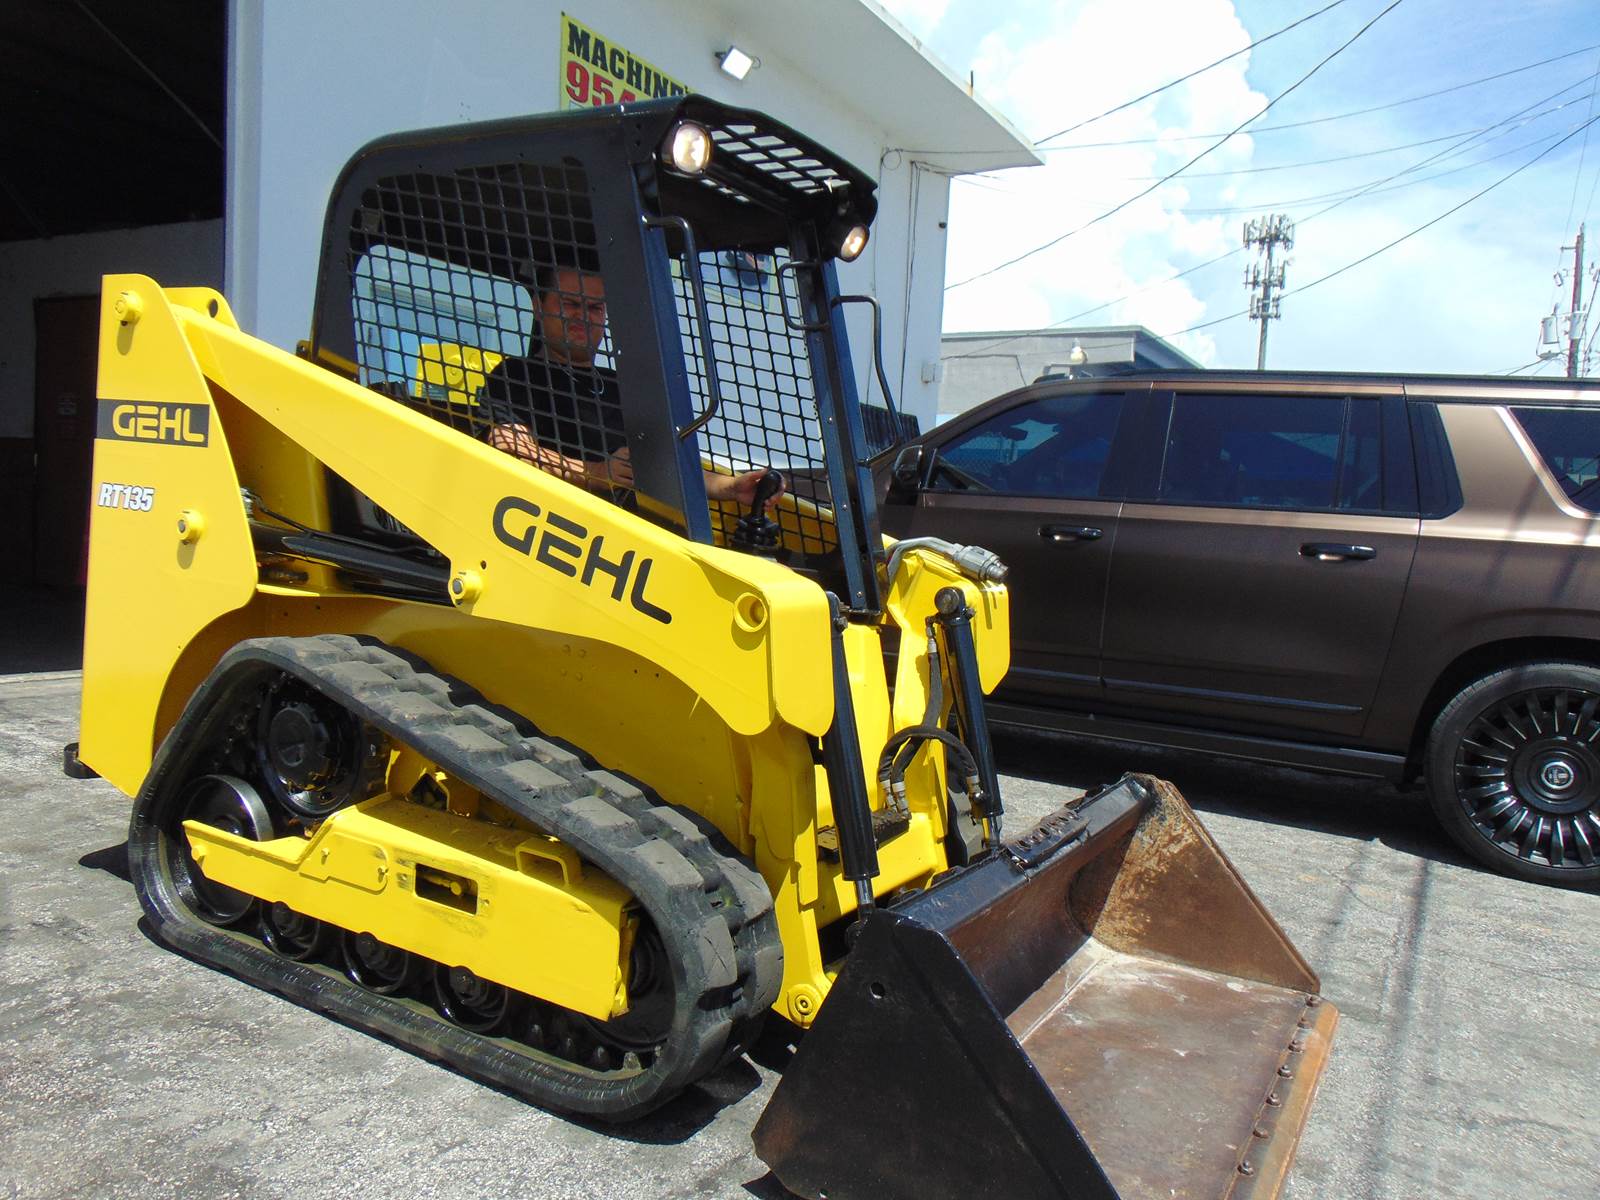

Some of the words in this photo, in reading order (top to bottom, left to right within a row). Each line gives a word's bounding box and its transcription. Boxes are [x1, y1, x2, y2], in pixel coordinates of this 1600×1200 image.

[112, 404, 205, 442] GEHL
[98, 482, 155, 512] RT135
[492, 495, 672, 625] GEHL
